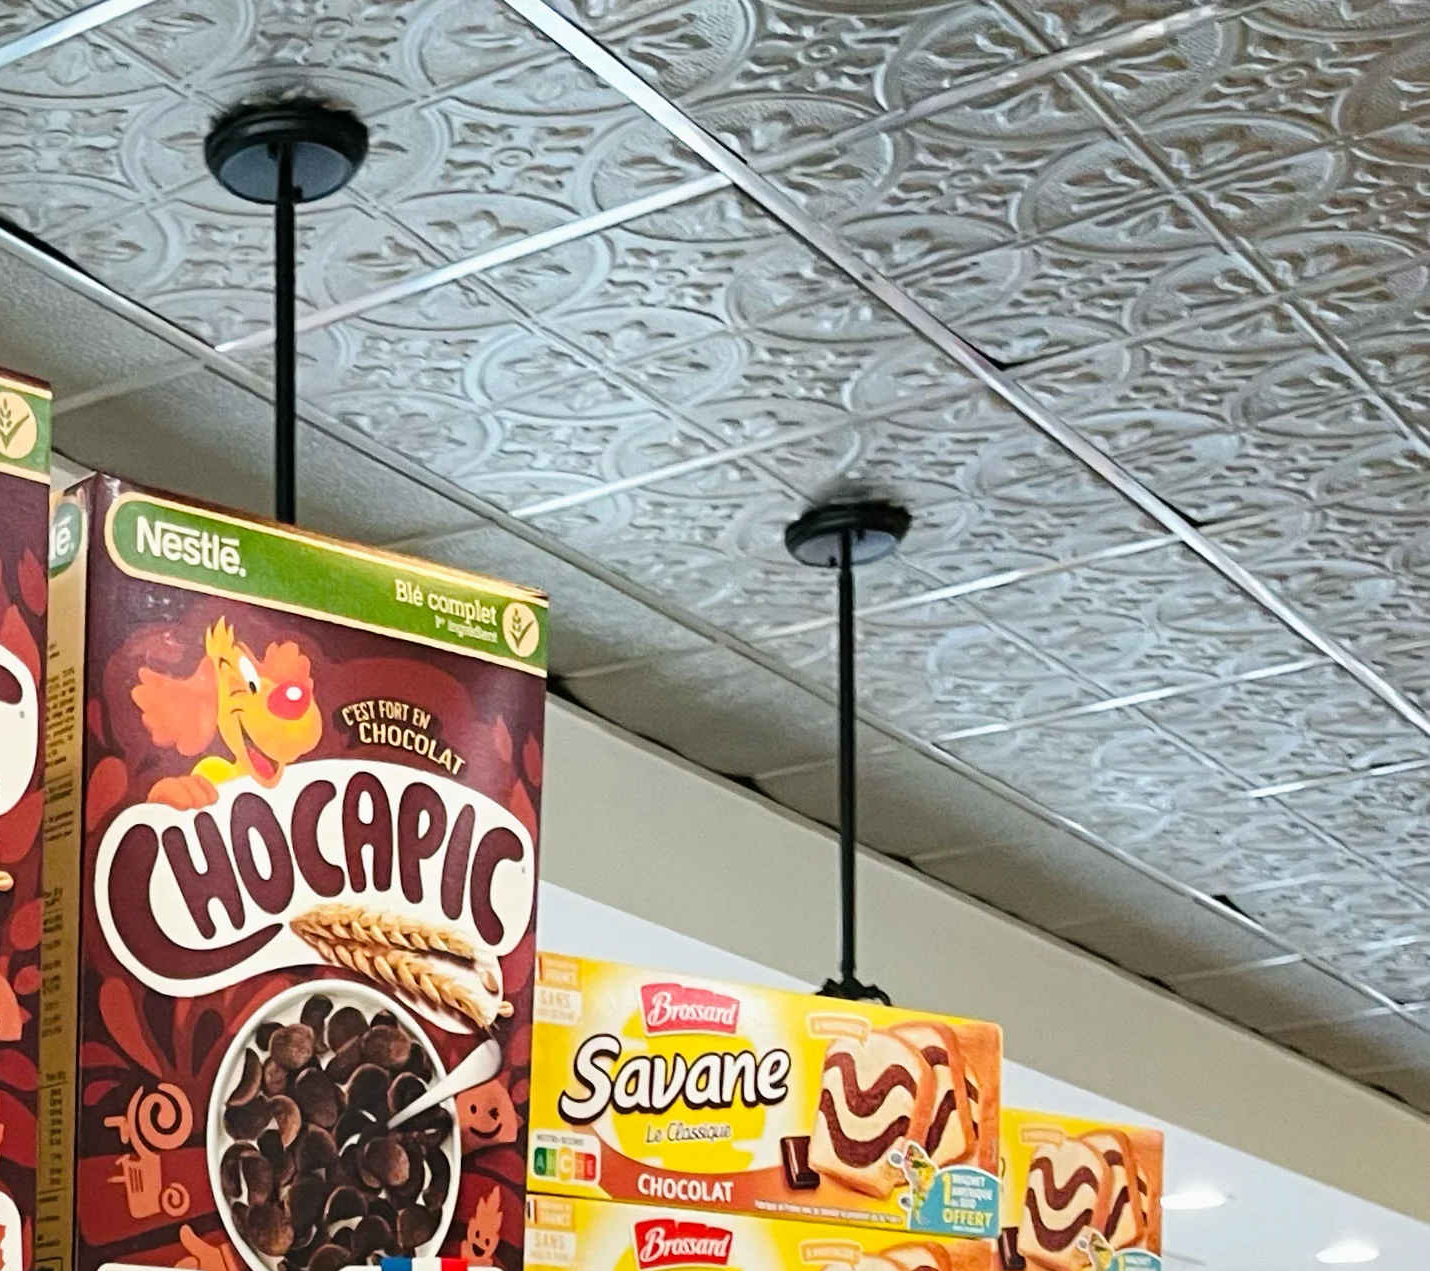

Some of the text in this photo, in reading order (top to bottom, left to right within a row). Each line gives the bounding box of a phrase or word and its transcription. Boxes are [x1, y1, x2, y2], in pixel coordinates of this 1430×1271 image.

[395, 578, 499, 627] Blé complet
[358, 724, 467, 776] CHOCOLAT
[107, 771, 526, 980] CHOCAPIC
[647, 992, 739, 1028] Brossard
[558, 1035, 791, 1124] Savane
[645, 1123, 664, 1144] Le
[637, 1174, 735, 1203] CHOCOLAT
[942, 1208, 992, 1228] OFFERT
[639, 1229, 731, 1263] Brossard
